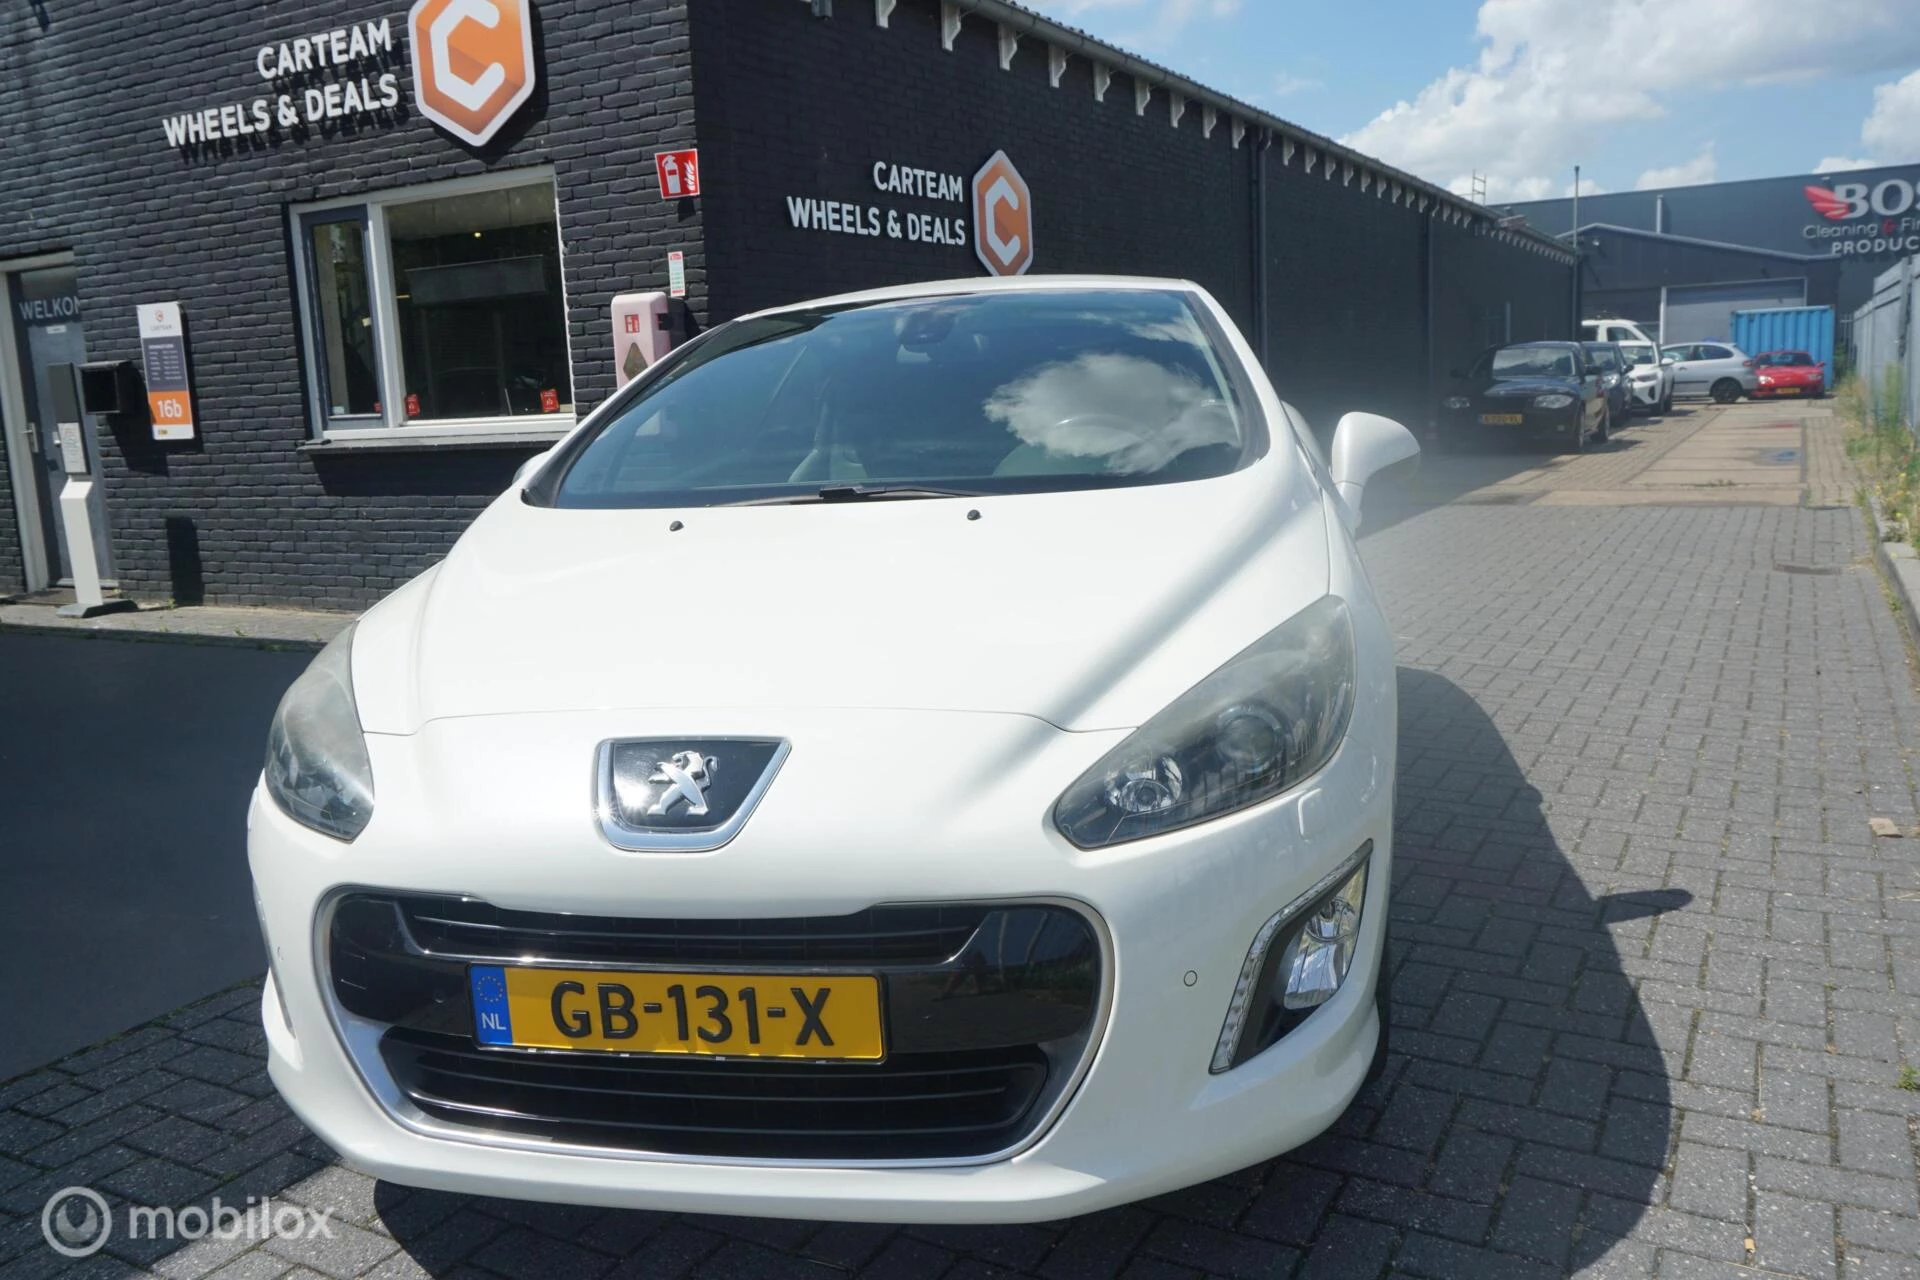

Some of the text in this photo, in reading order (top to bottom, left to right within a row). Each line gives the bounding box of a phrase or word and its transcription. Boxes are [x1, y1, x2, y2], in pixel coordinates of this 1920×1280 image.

[257, 19, 393, 79] CARTEAM
[162, 74, 400, 147] WHEELS & DEALS
[873, 161, 964, 202] CARTEAM
[1835, 179, 1920, 219] BO
[787, 196, 966, 246] WHEELS & DEALS
[1803, 223, 1877, 240] Cleaning
[157, 399, 182, 418] 16b
[481, 1012, 507, 1030] NL
[550, 980, 836, 1047] GB-131-X
